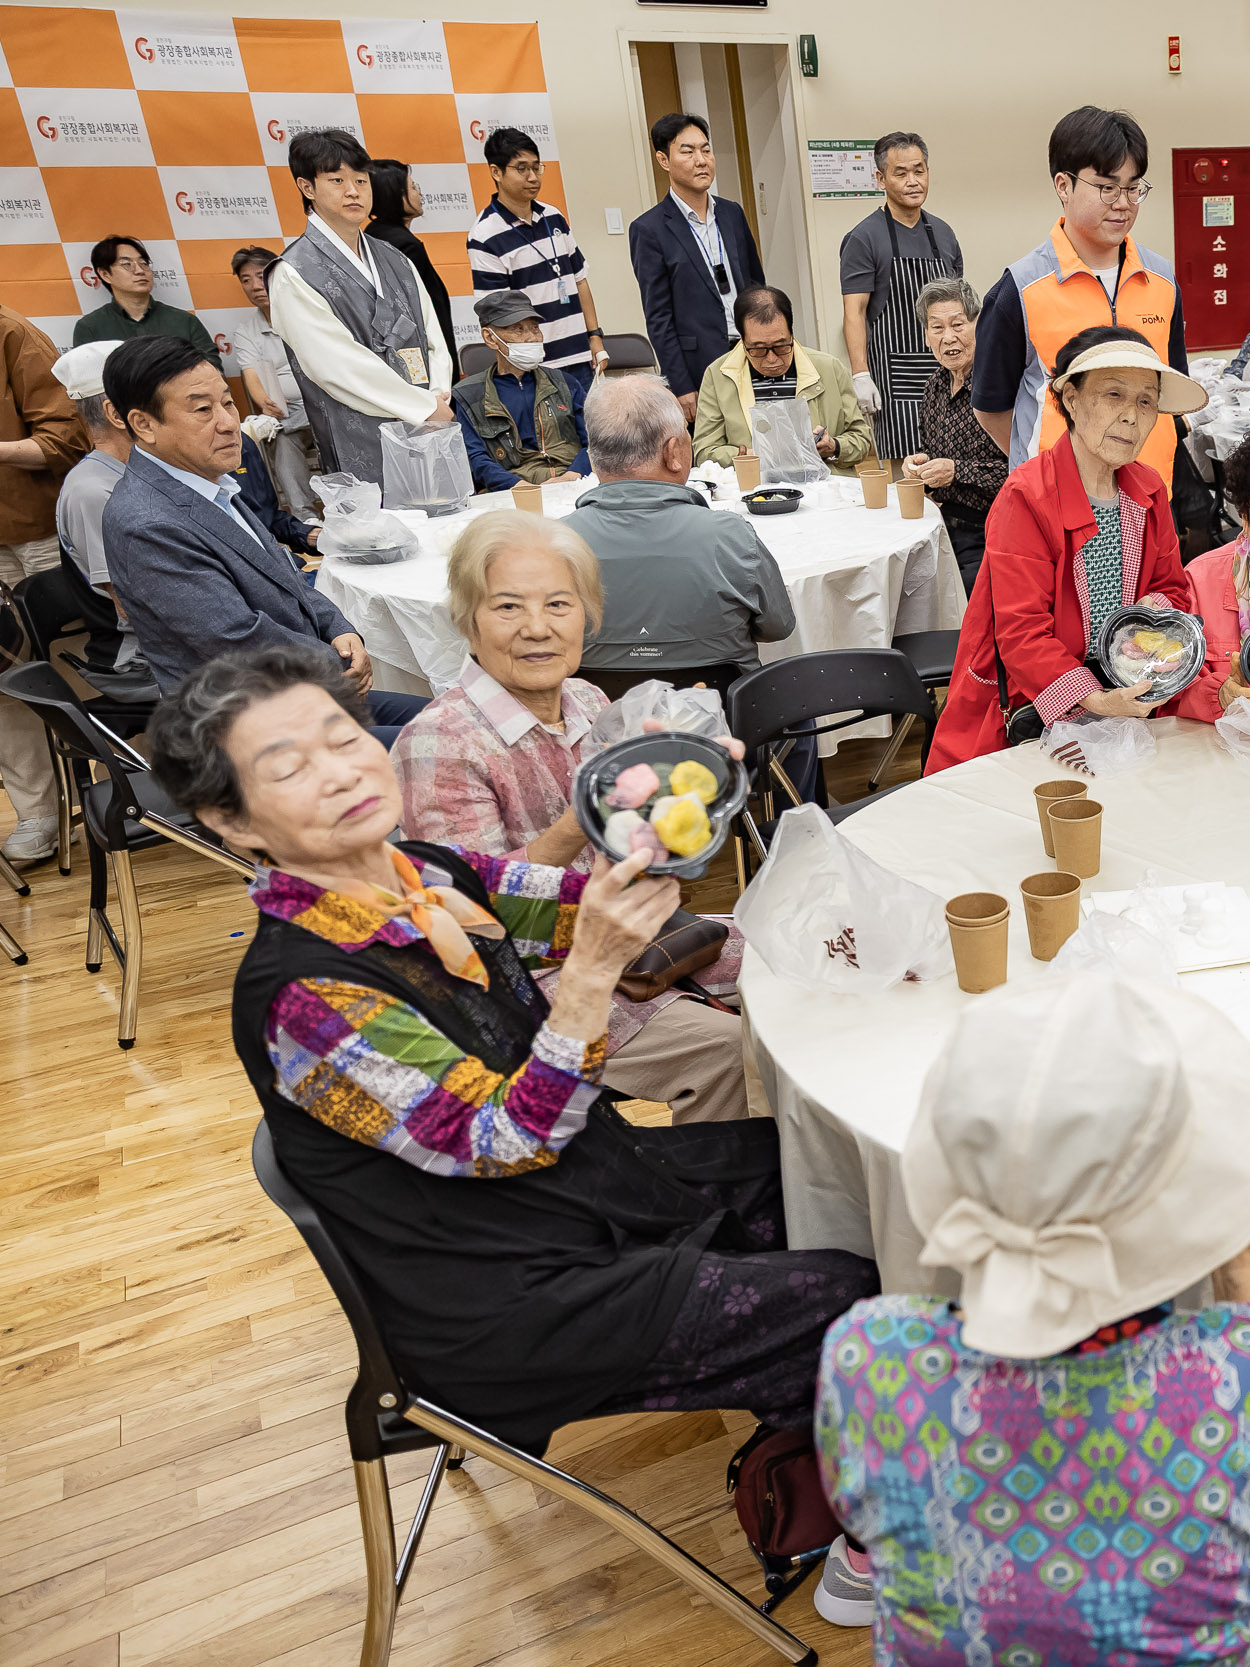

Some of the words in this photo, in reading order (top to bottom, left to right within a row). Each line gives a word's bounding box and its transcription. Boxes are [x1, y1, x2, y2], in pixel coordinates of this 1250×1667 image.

[157, 44, 233, 59] 광장종합사회복지관
[376, 51, 442, 63] 광장종합사회복지관
[59, 122, 139, 135] 광장종합사회복지관
[196, 196, 268, 209] 광장종합사회복지관
[1212, 235, 1228, 305] 소화전
